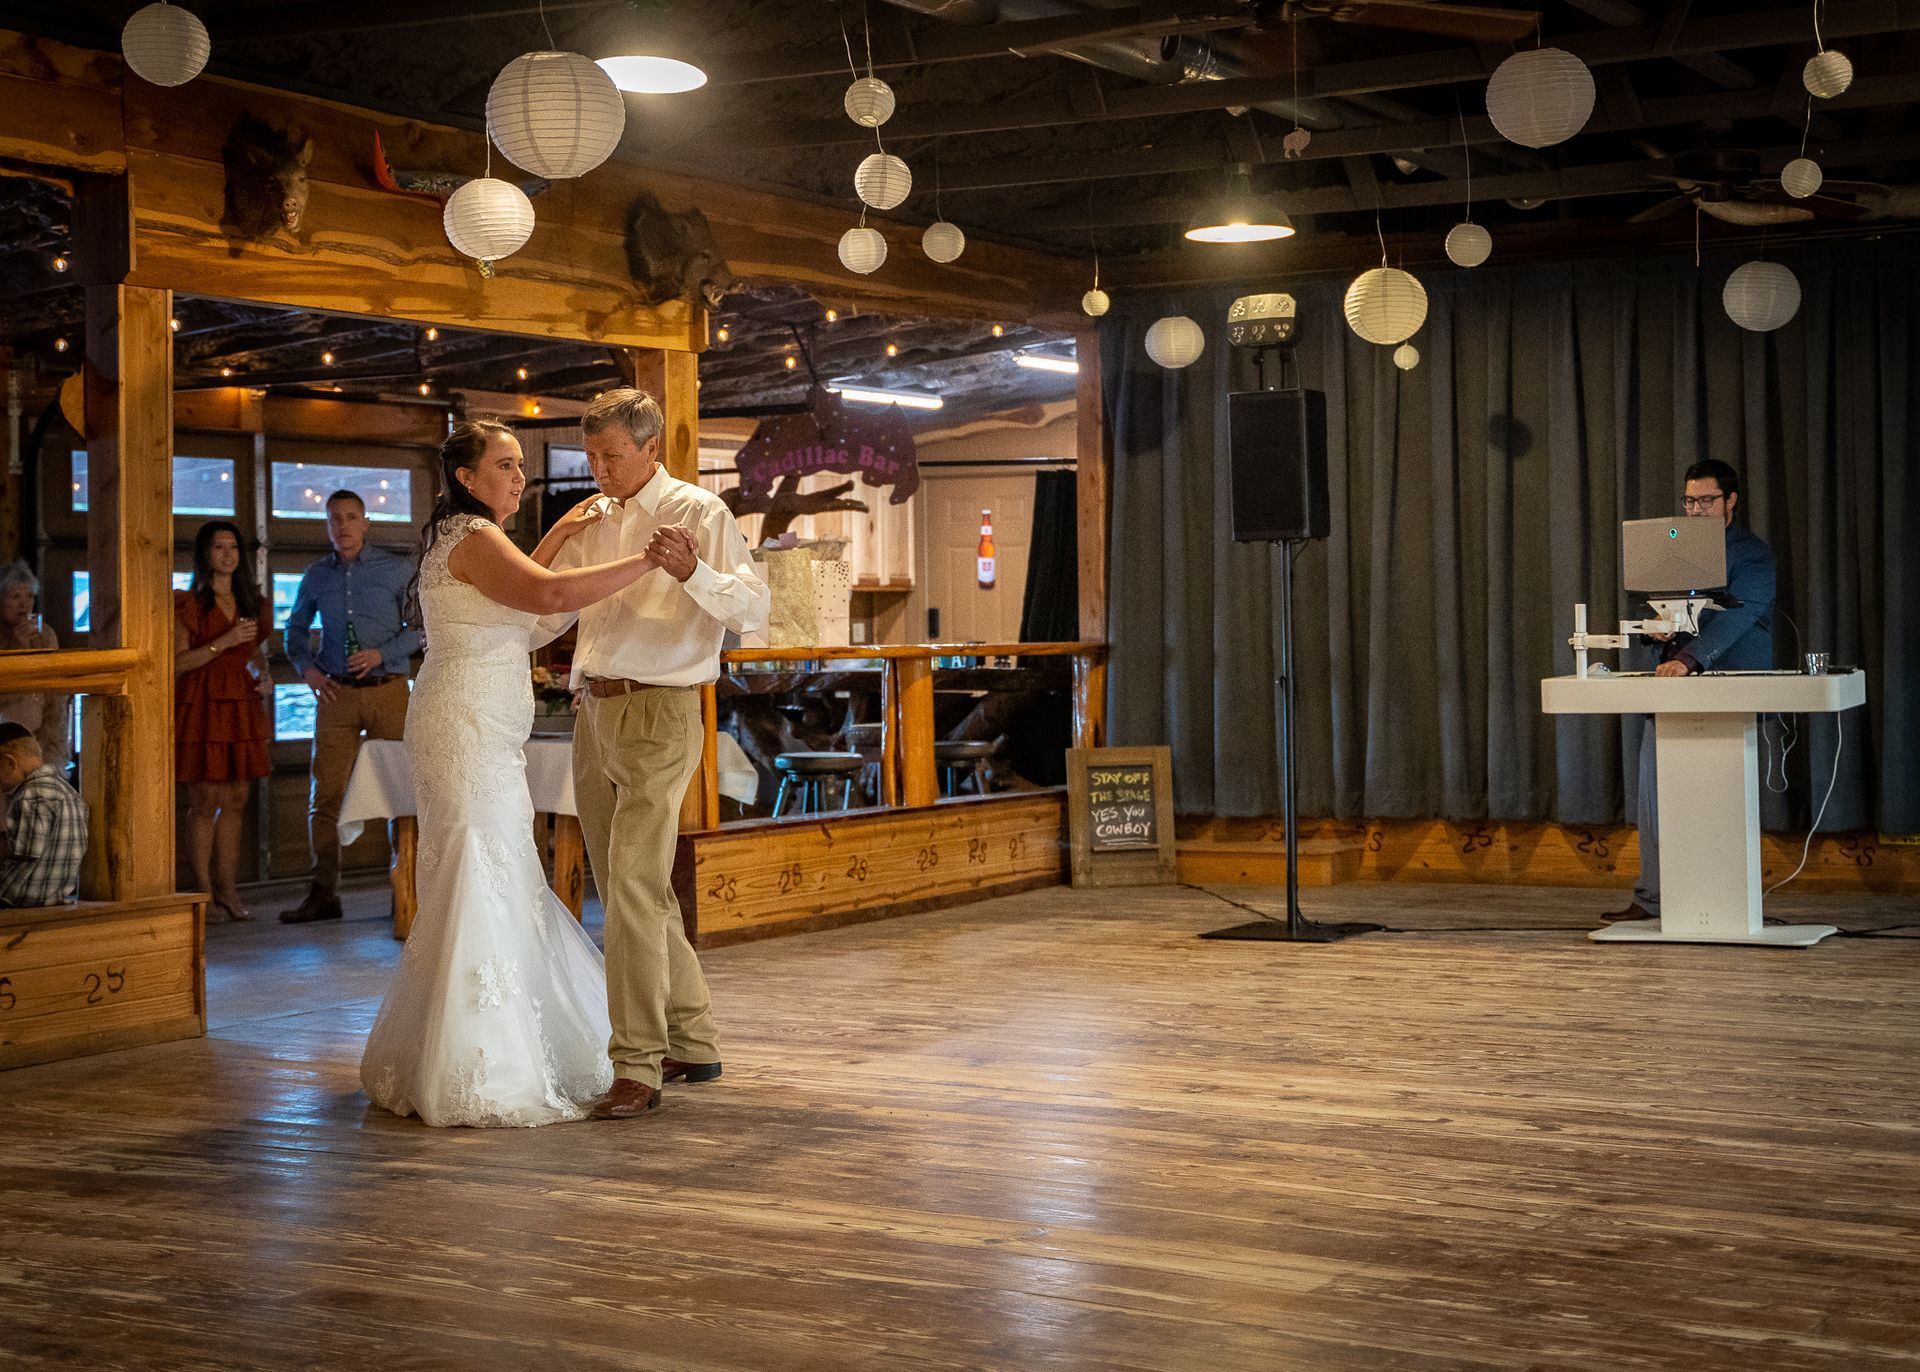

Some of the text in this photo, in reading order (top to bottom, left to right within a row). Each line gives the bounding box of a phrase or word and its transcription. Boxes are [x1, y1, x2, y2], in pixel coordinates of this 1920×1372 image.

[752, 445, 900, 482] Cadillac Bar
[1091, 772, 1150, 786] STAY OFF
[1090, 788, 1150, 804] THE STAGE
[1091, 806, 1119, 822] YES
[1096, 822, 1151, 837] COWBOY
